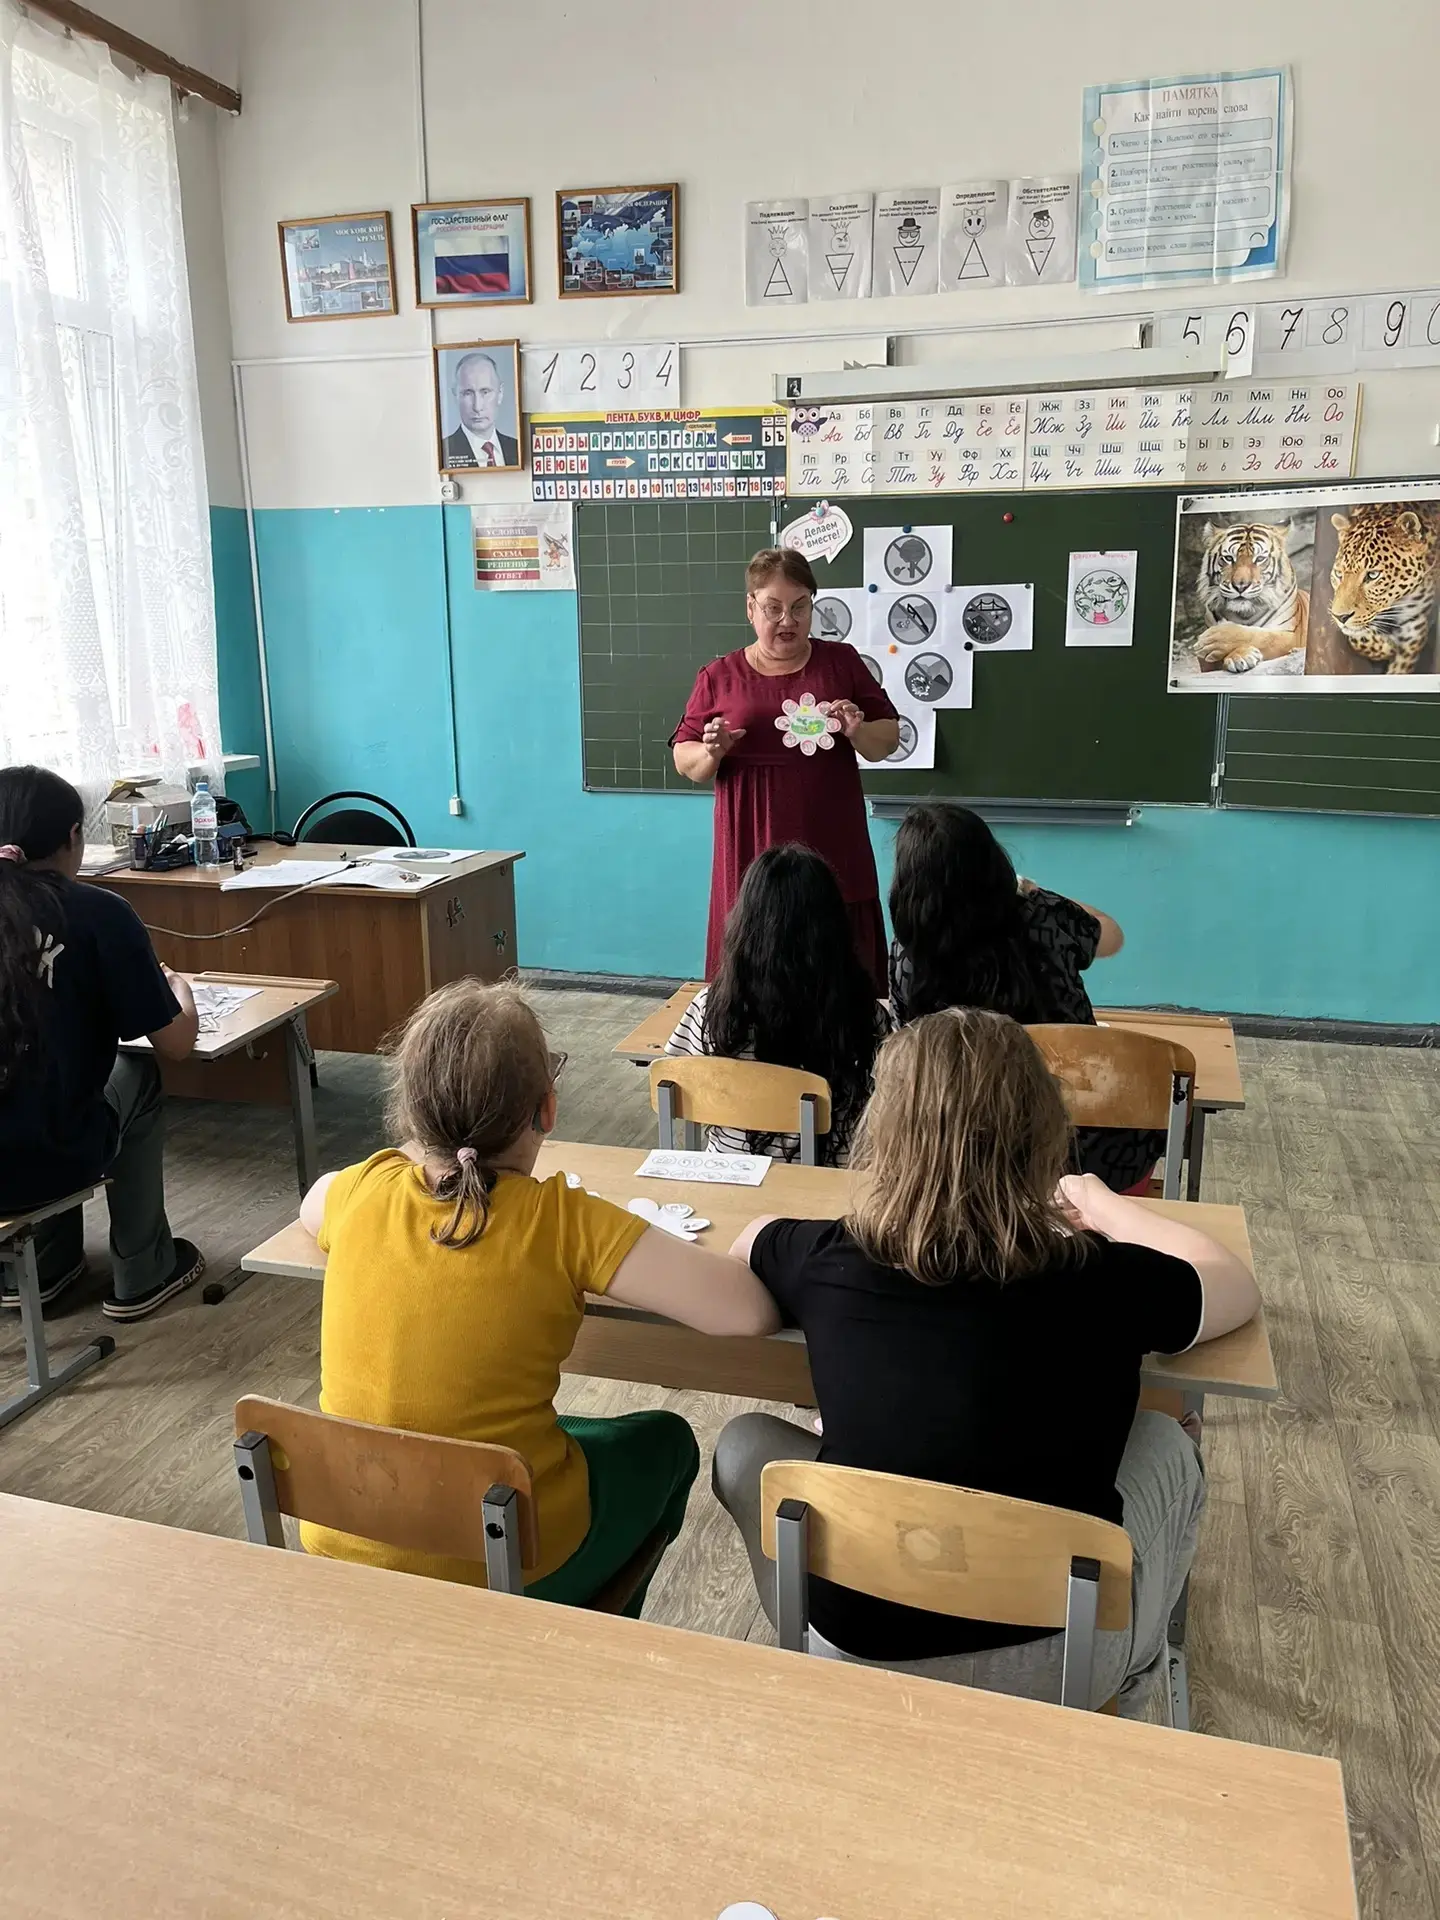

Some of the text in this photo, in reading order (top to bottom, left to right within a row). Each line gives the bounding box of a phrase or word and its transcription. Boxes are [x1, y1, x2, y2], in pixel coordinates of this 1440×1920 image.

[1163, 87, 1218, 102] ПАМЯТКА
[432, 212, 508, 224] ГОСУДАРСТВЕННЫЙ ФЛАГ
[1226, 311, 1248, 355] 6
[1281, 307, 1304, 350] 7
[1323, 307, 1348, 344] 8
[1383, 301, 1406, 347] 9
[542, 350, 672, 393] 1 2 3 4
[829, 389, 1343, 420] Аа Бб Вв Гг Дд Ее Жж Зз Ии Йй Кк Лл Мм Нн Оо
[606, 412, 635, 422] ЛЕНТА
[638, 412, 661, 421] БУКВ
[674, 410, 701, 421] ЦИФР
[821, 403, 1343, 444] Аа Бб Вв Гг Дд Ее Жж Зз Ии Йй Кк Лл Мм Нн Оо
[535, 431, 784, 449] А О У Э Ы Й Р Л М Н Б В Г З Д Ж Ь Ъ
[804, 435, 1338, 464] Пп Рр Сс Тт Уу Фф Хх Цц Чч Шш Щщ Ъ Ы Ь Ээ Юю Яя
[536, 455, 763, 471] Я Ё Ю Е И П Ф К С Т Ш Ц Ч Щ Х
[798, 452, 1338, 490] Пп Рр Сс Тт Уу Фф Хх Цц Чч Шш Щщ Ээ Юю Яя
[536, 481, 784, 495] 0 1 2 3 4 5 6 7 8 9 10 11 12 13 14 15 16 17 18 19 20
[805, 521, 838, 539] Делаем
[806, 530, 840, 548] вместе!
